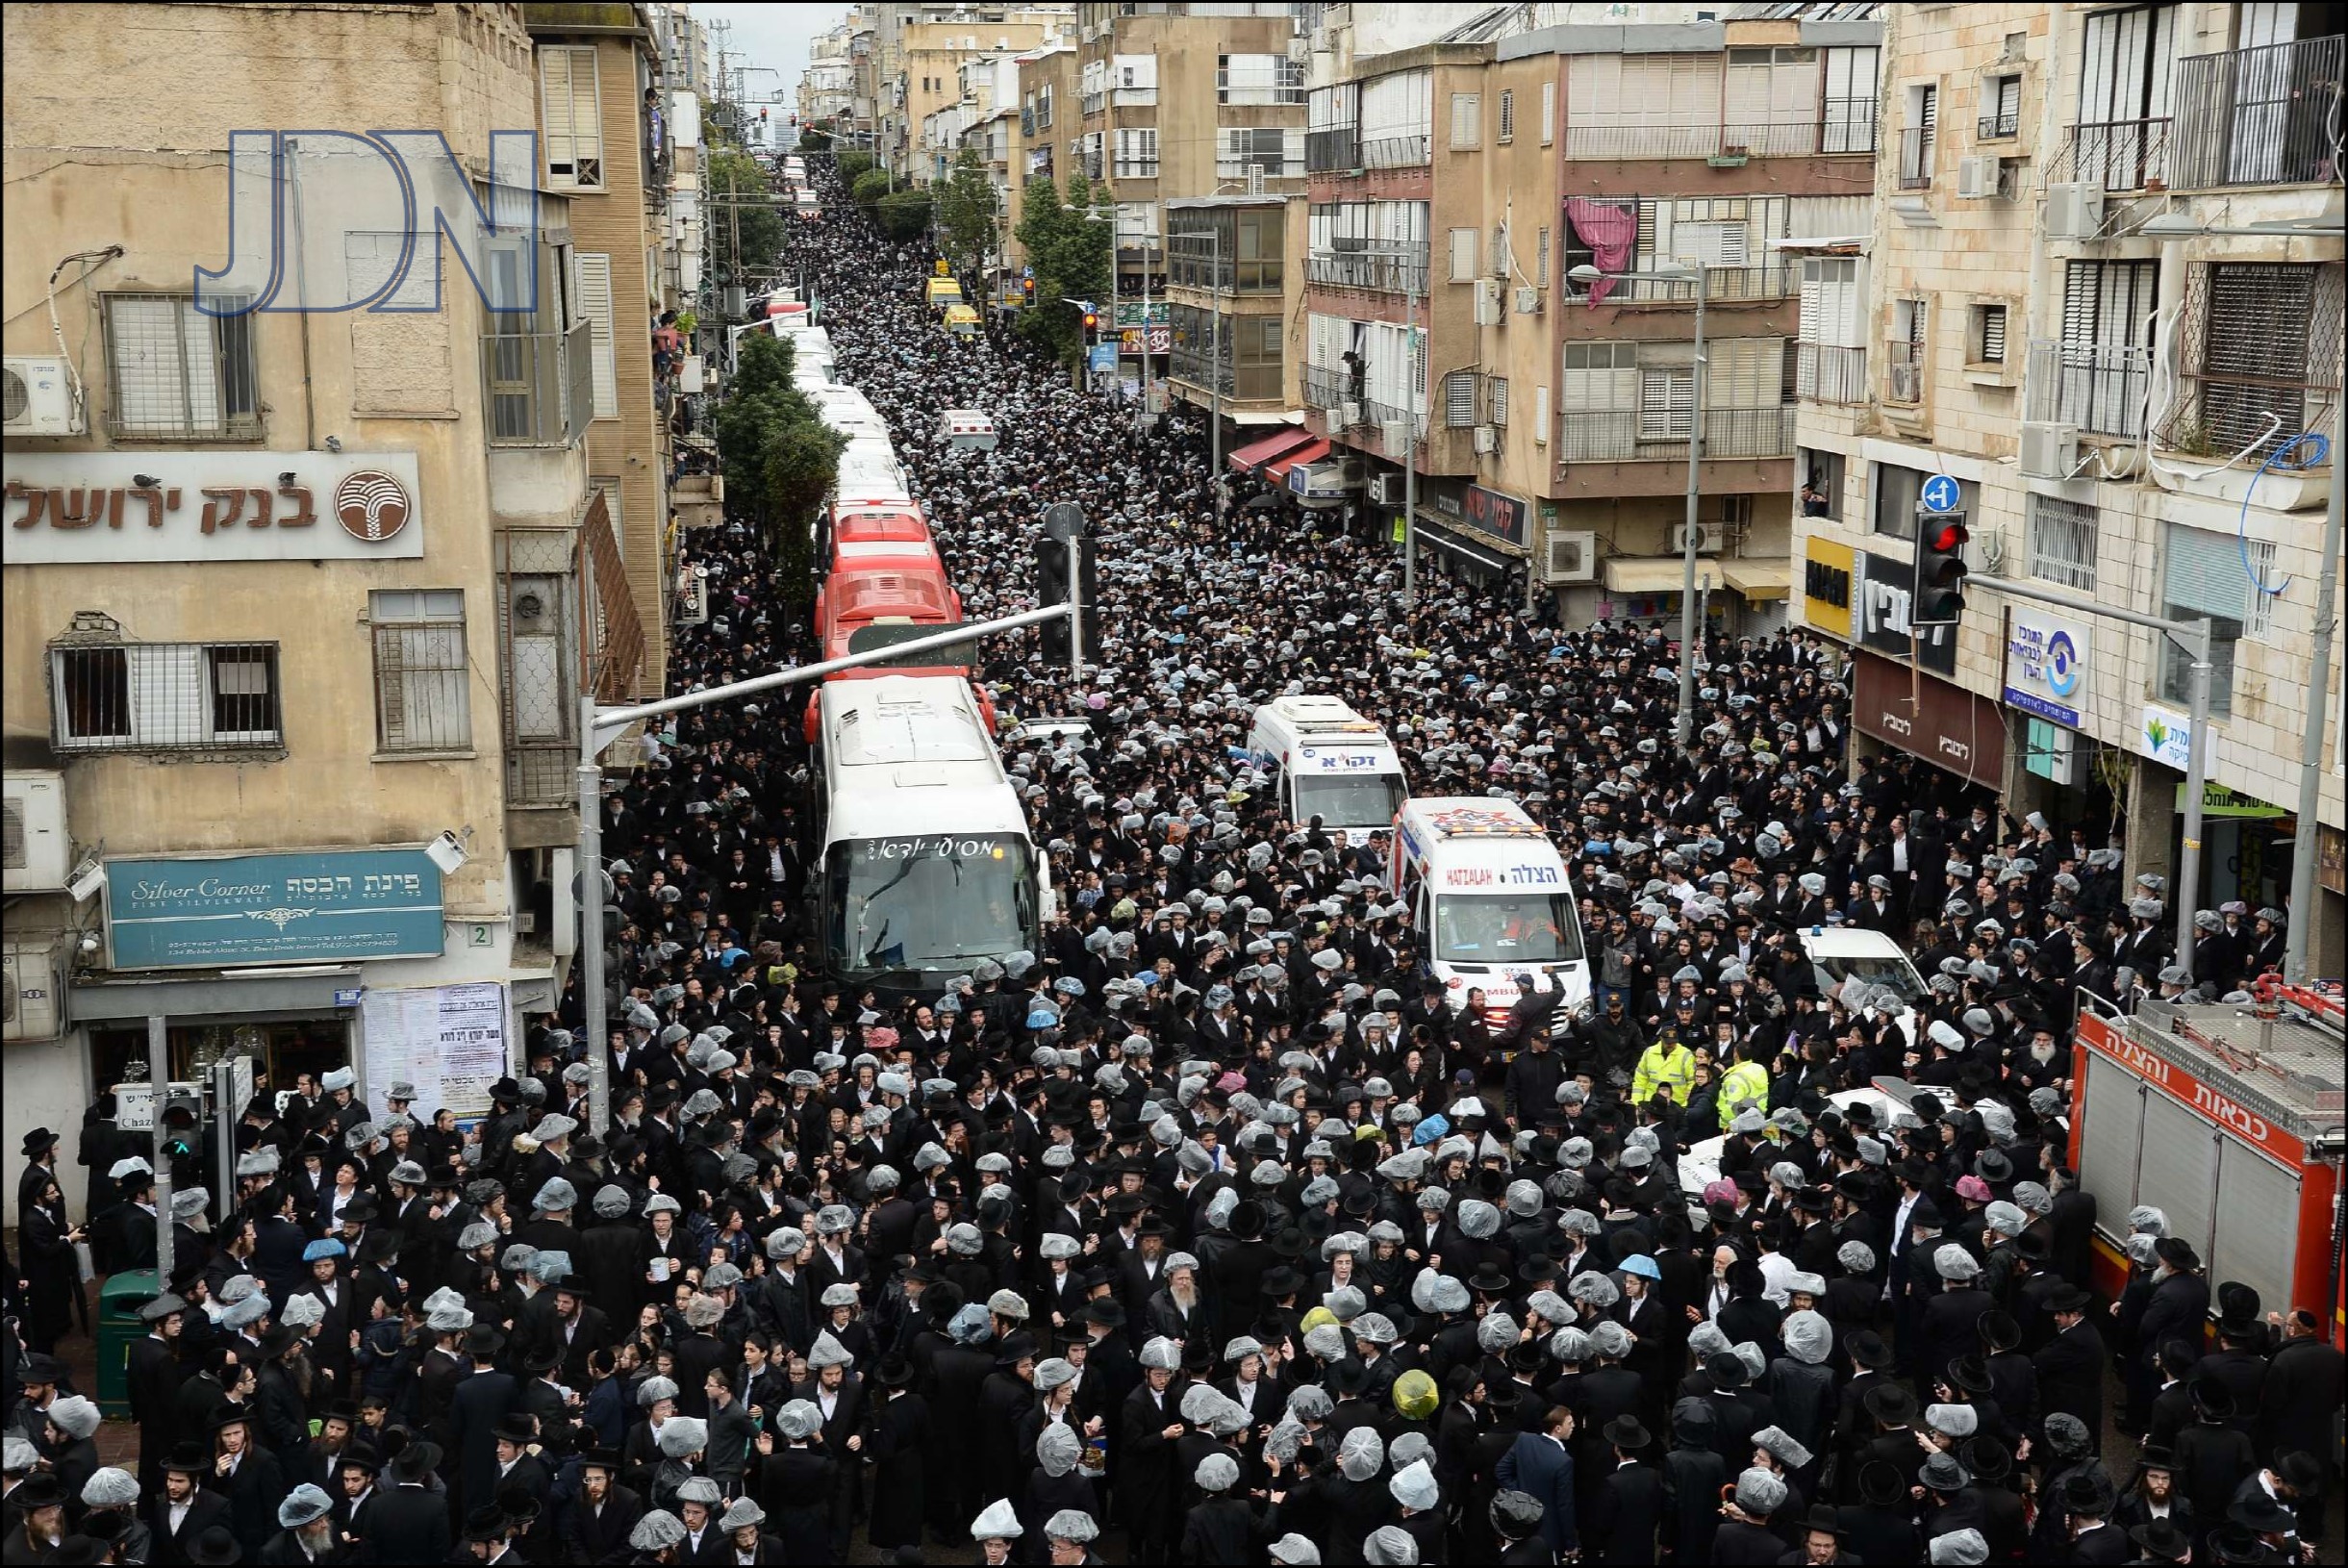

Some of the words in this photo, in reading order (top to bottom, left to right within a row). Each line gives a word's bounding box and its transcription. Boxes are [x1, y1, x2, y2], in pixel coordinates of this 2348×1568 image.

[4, 479, 182, 528] ירושל
[200, 486, 318, 534] בנק
[2019, 625, 2043, 645] המרכז
[2009, 640, 2041, 663] לבריאות
[2024, 662, 2041, 681] העין
[934, 837, 997, 857] מסיעי
[364, 873, 420, 892] פינת
[1447, 869, 1493, 886] HATZALAH
[1510, 864, 1558, 884] הצלה
[131, 879, 194, 900] Silver
[198, 877, 271, 897] Corner
[287, 876, 353, 896] הכסף
[475, 926, 486, 943] 2
[2105, 1029, 2170, 1085] והצלה
[2193, 1081, 2269, 1142] כבאות
[122, 1118, 155, 1127] Chaz
